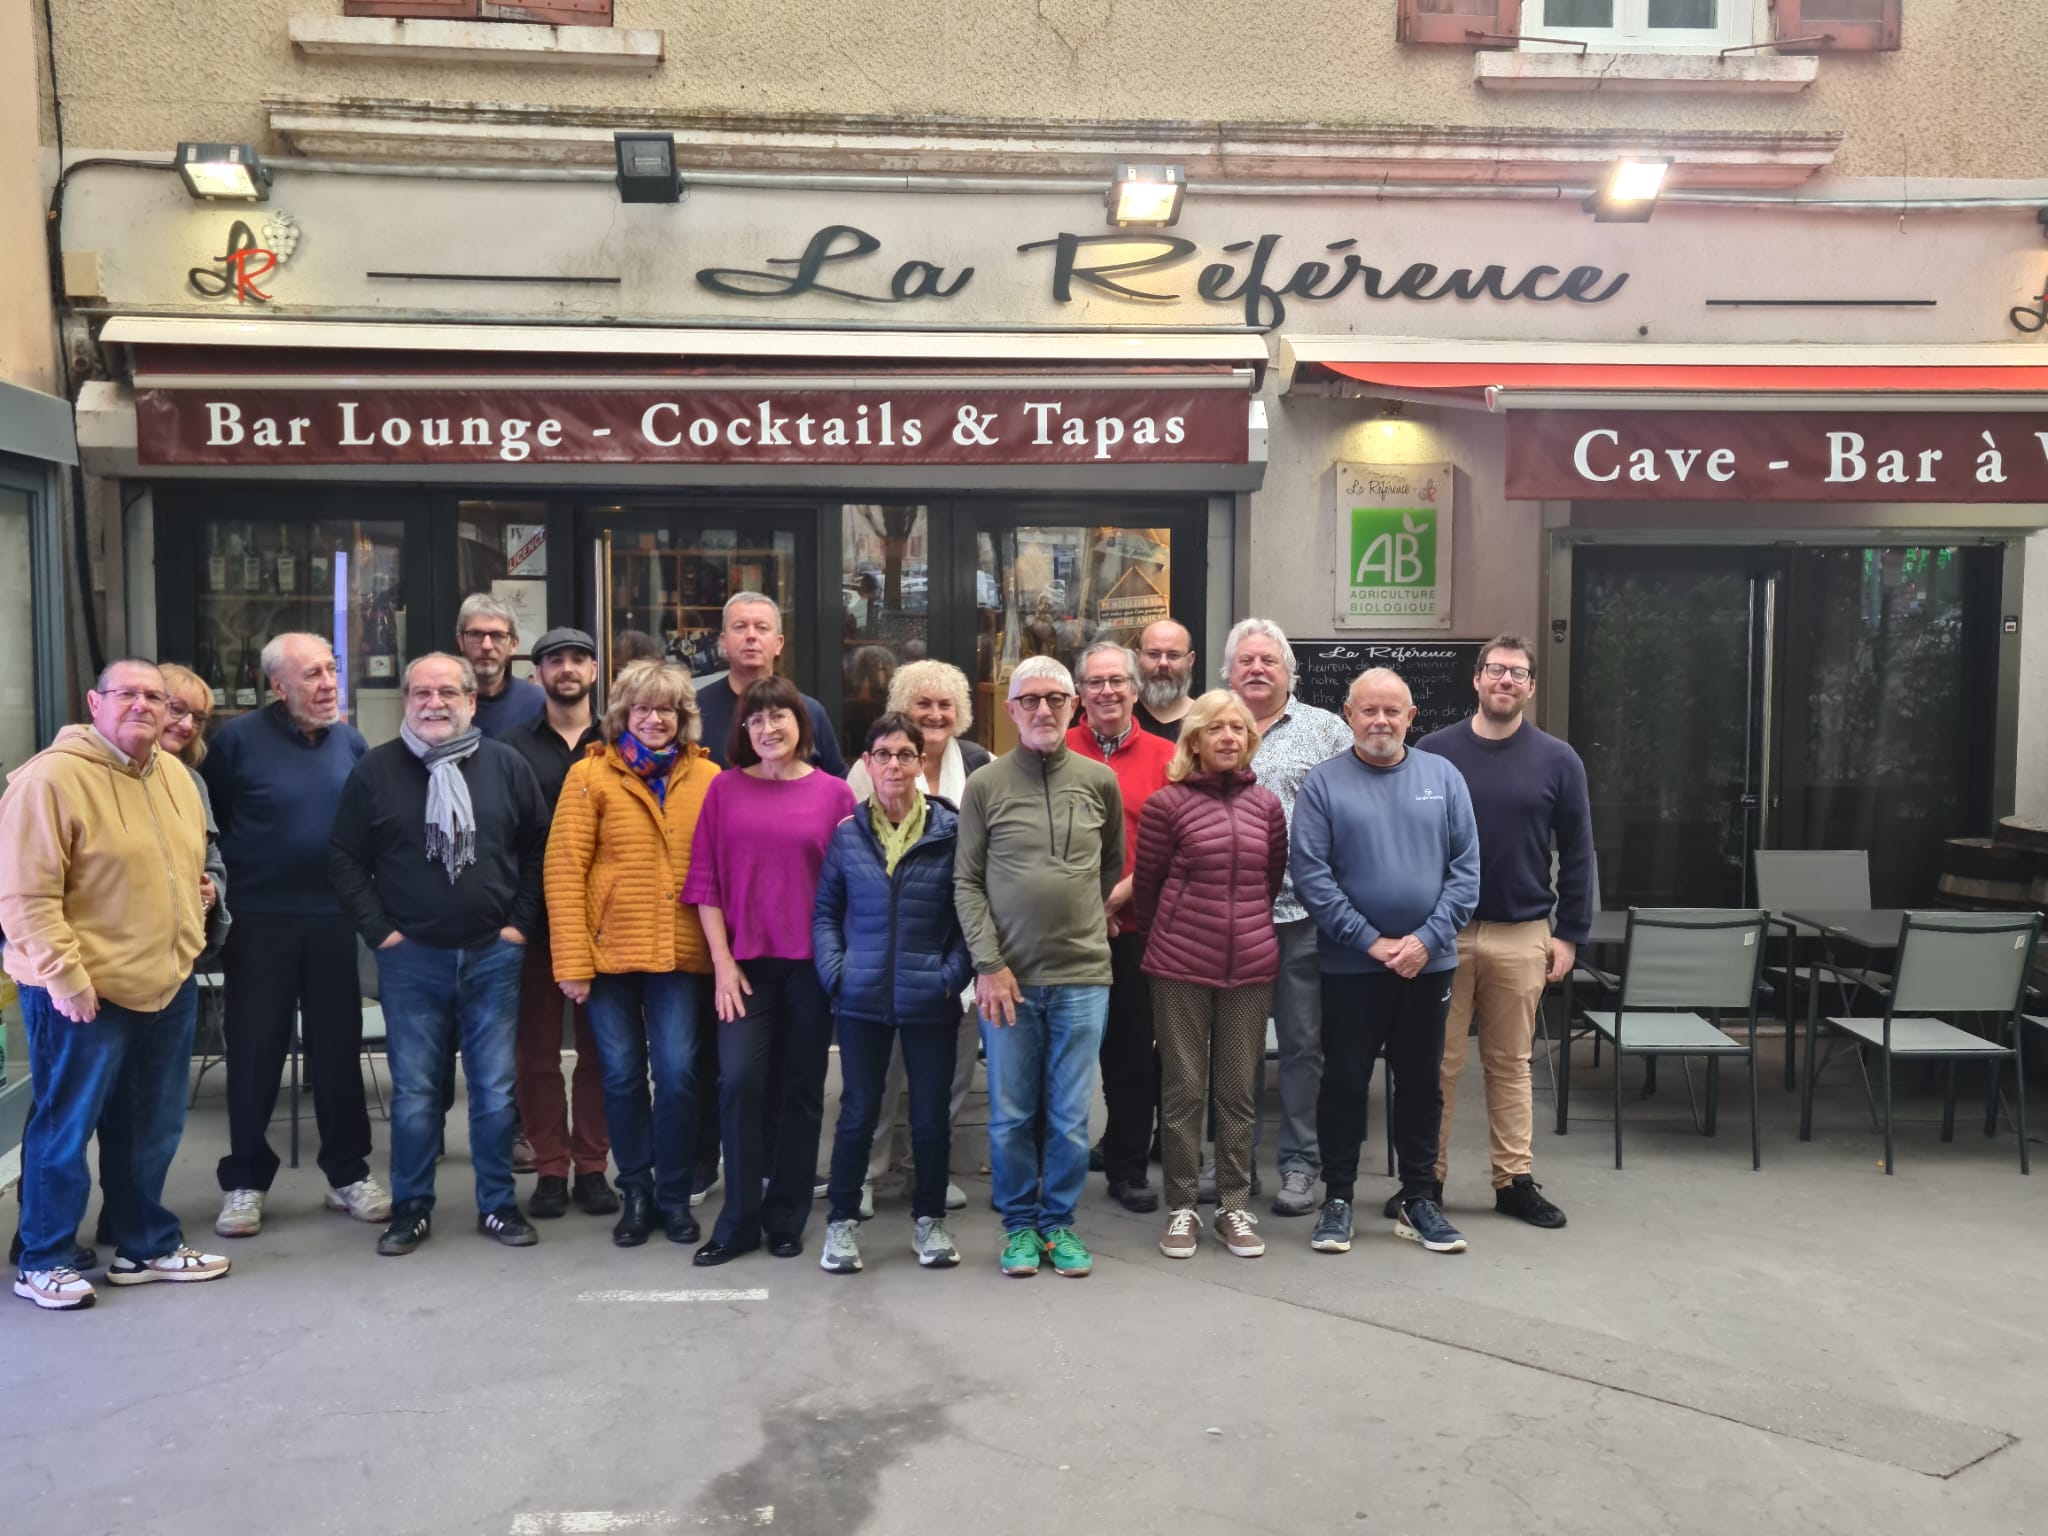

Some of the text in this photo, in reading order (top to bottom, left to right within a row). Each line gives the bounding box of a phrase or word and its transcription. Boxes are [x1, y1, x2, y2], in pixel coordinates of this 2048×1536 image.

[695, 224, 1630, 331] La Référence
[205, 400, 1186, 462] Bar Lounge - Cocktails & Tapas
[1573, 429, 1737, 483] Cave
[1769, 459, 1789, 470] -
[1824, 431, 1943, 483] Bar
[1975, 430, 2007, 483] à
[1357, 533, 1423, 583] AB
[1350, 589, 1436, 599] AGRICULTURE
[1350, 602, 1436, 612] BIOLOGIQUE
[1319, 647, 1457, 662] La Référence
